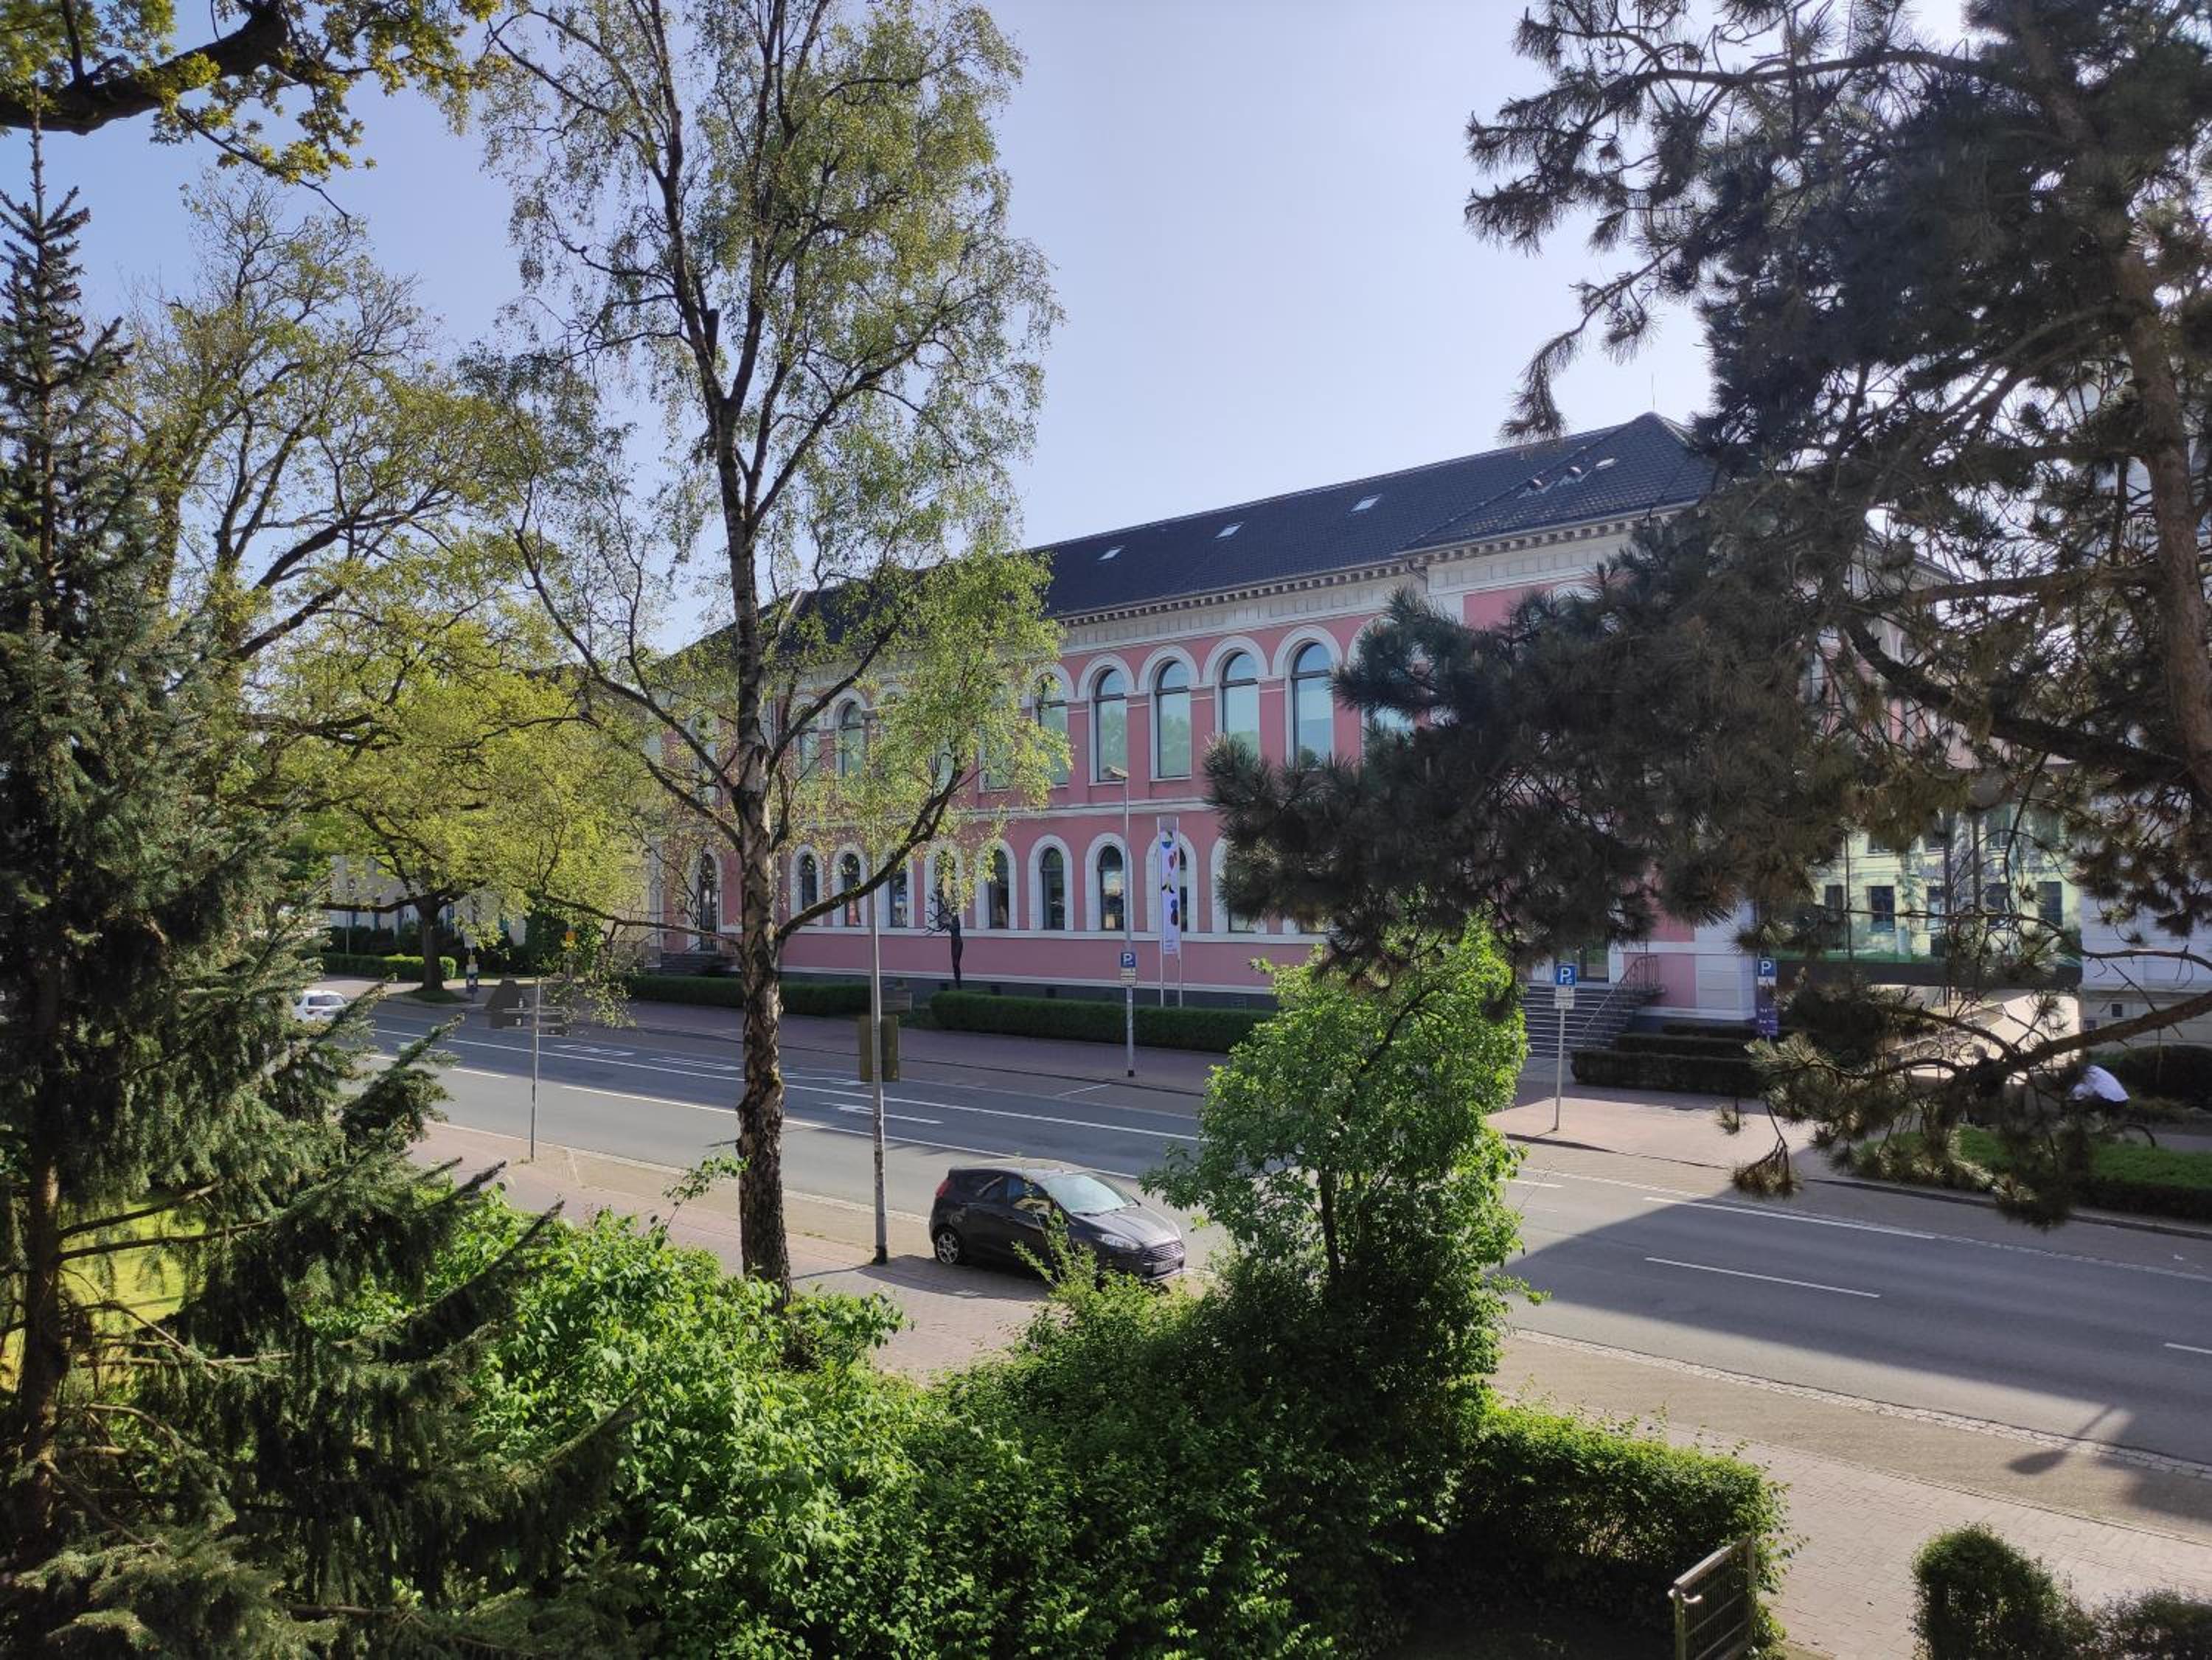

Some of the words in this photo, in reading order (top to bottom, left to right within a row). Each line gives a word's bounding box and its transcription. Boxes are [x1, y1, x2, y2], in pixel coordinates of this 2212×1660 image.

[1123, 953, 1133, 965] P
[1761, 960, 1771, 974] P
[1560, 967, 1571, 983] P
